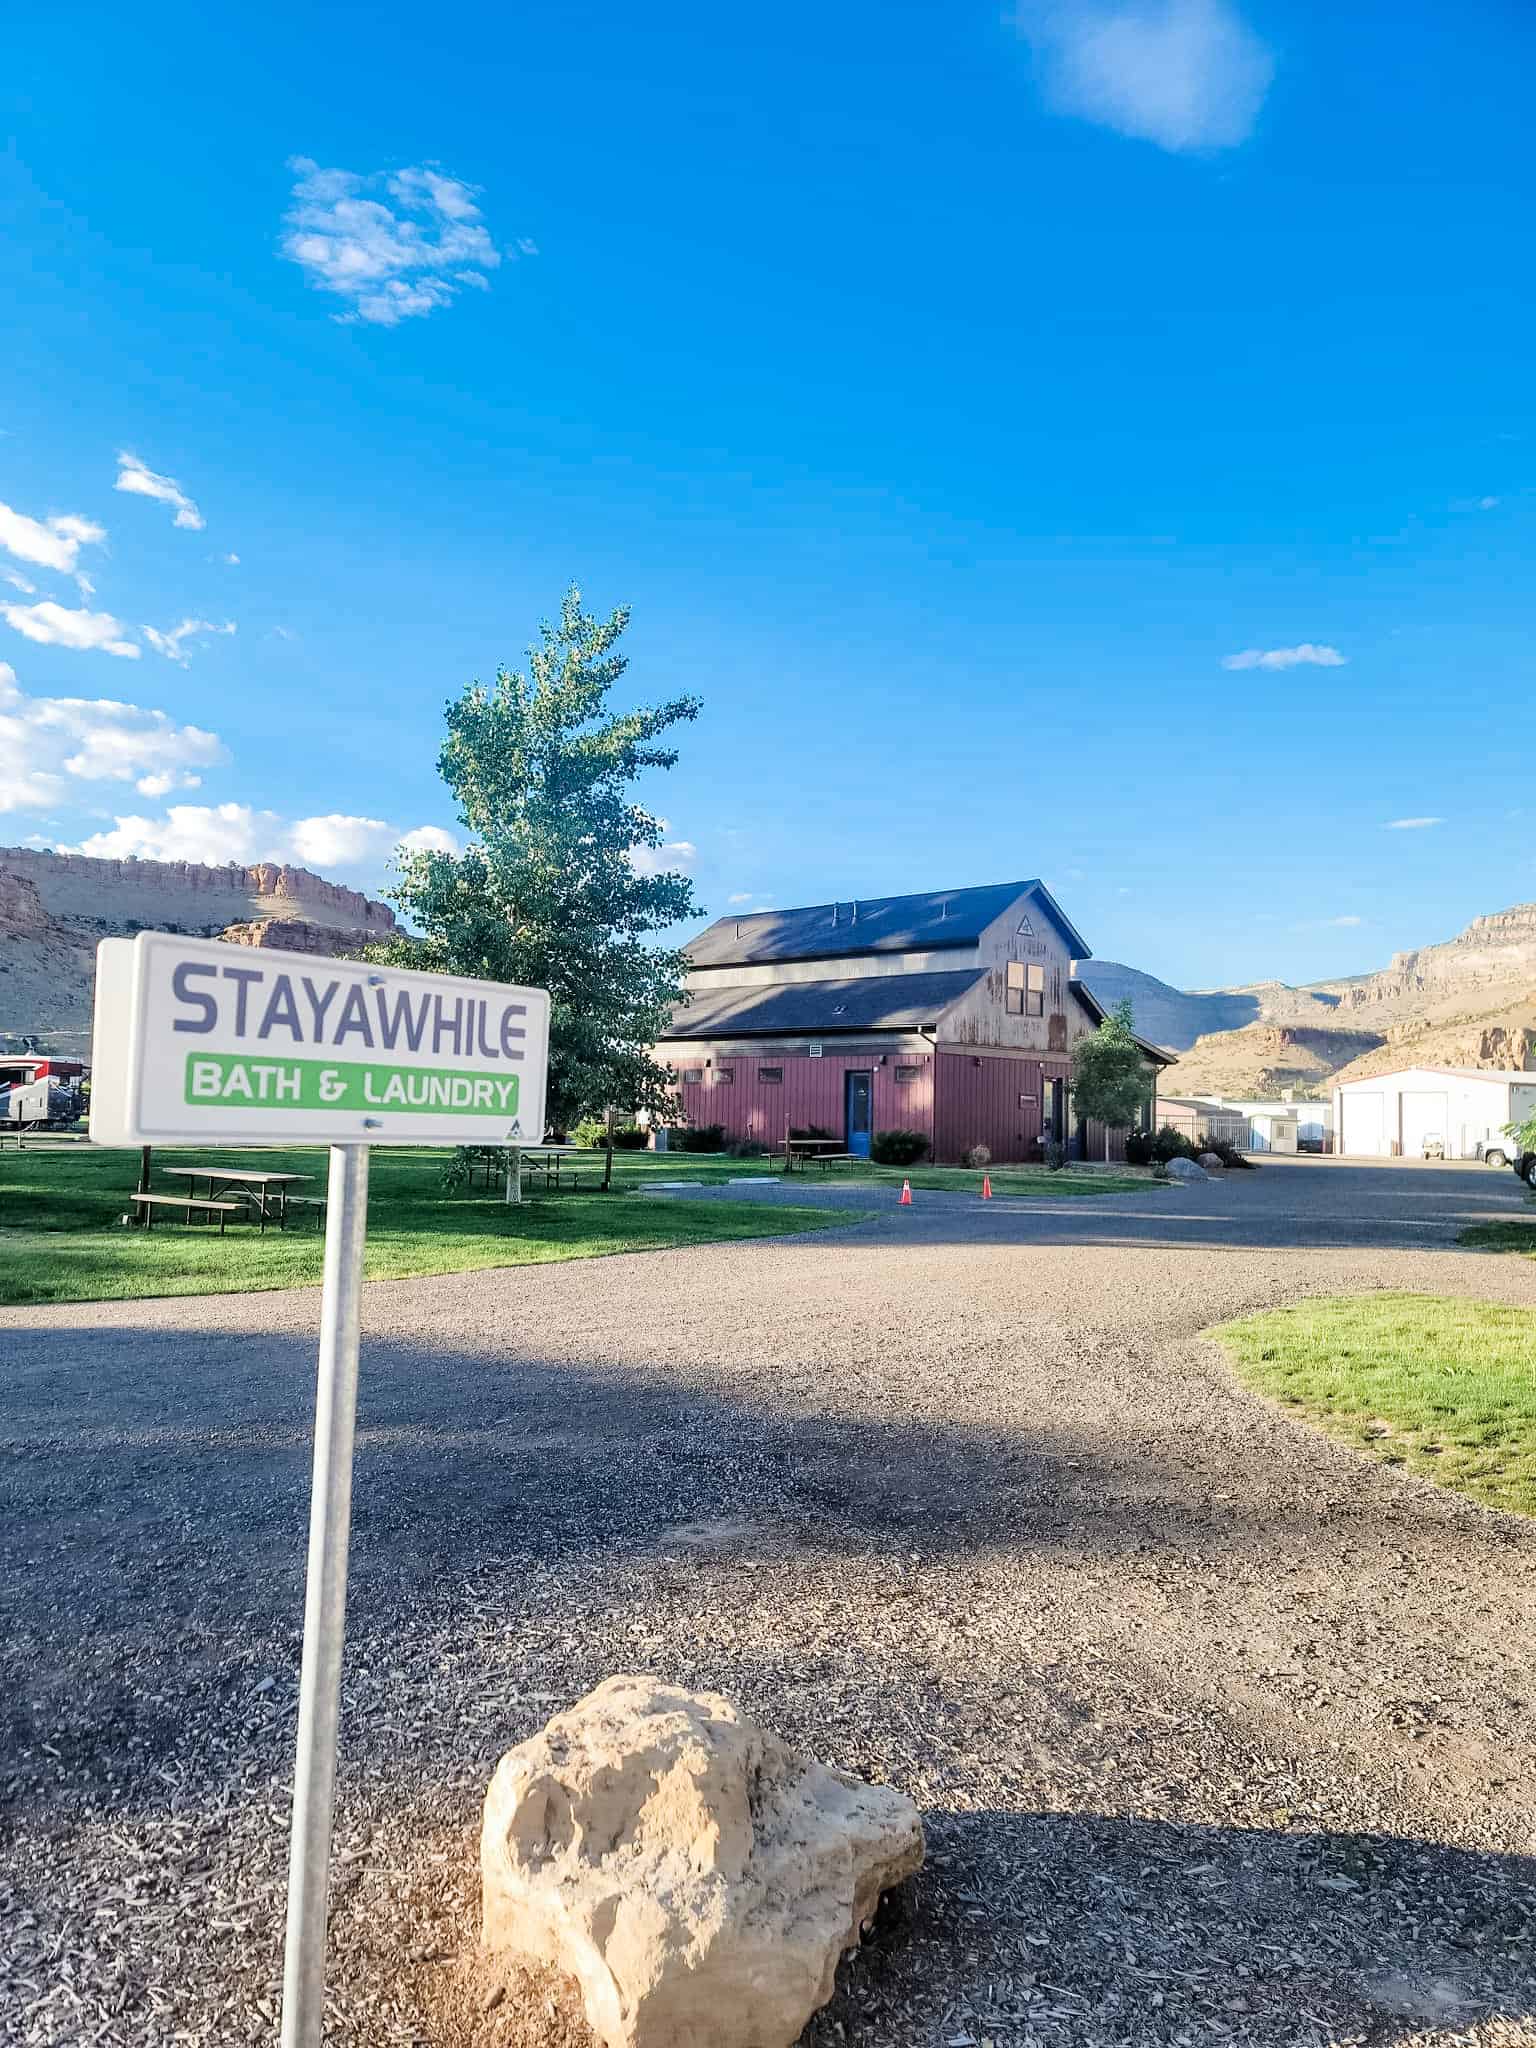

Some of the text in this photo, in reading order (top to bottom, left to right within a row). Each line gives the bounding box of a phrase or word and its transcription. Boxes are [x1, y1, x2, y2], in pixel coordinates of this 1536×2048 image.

[173, 961, 527, 1060] STAYAWHILE
[192, 1061, 514, 1109] BATH & LAUNDRY
